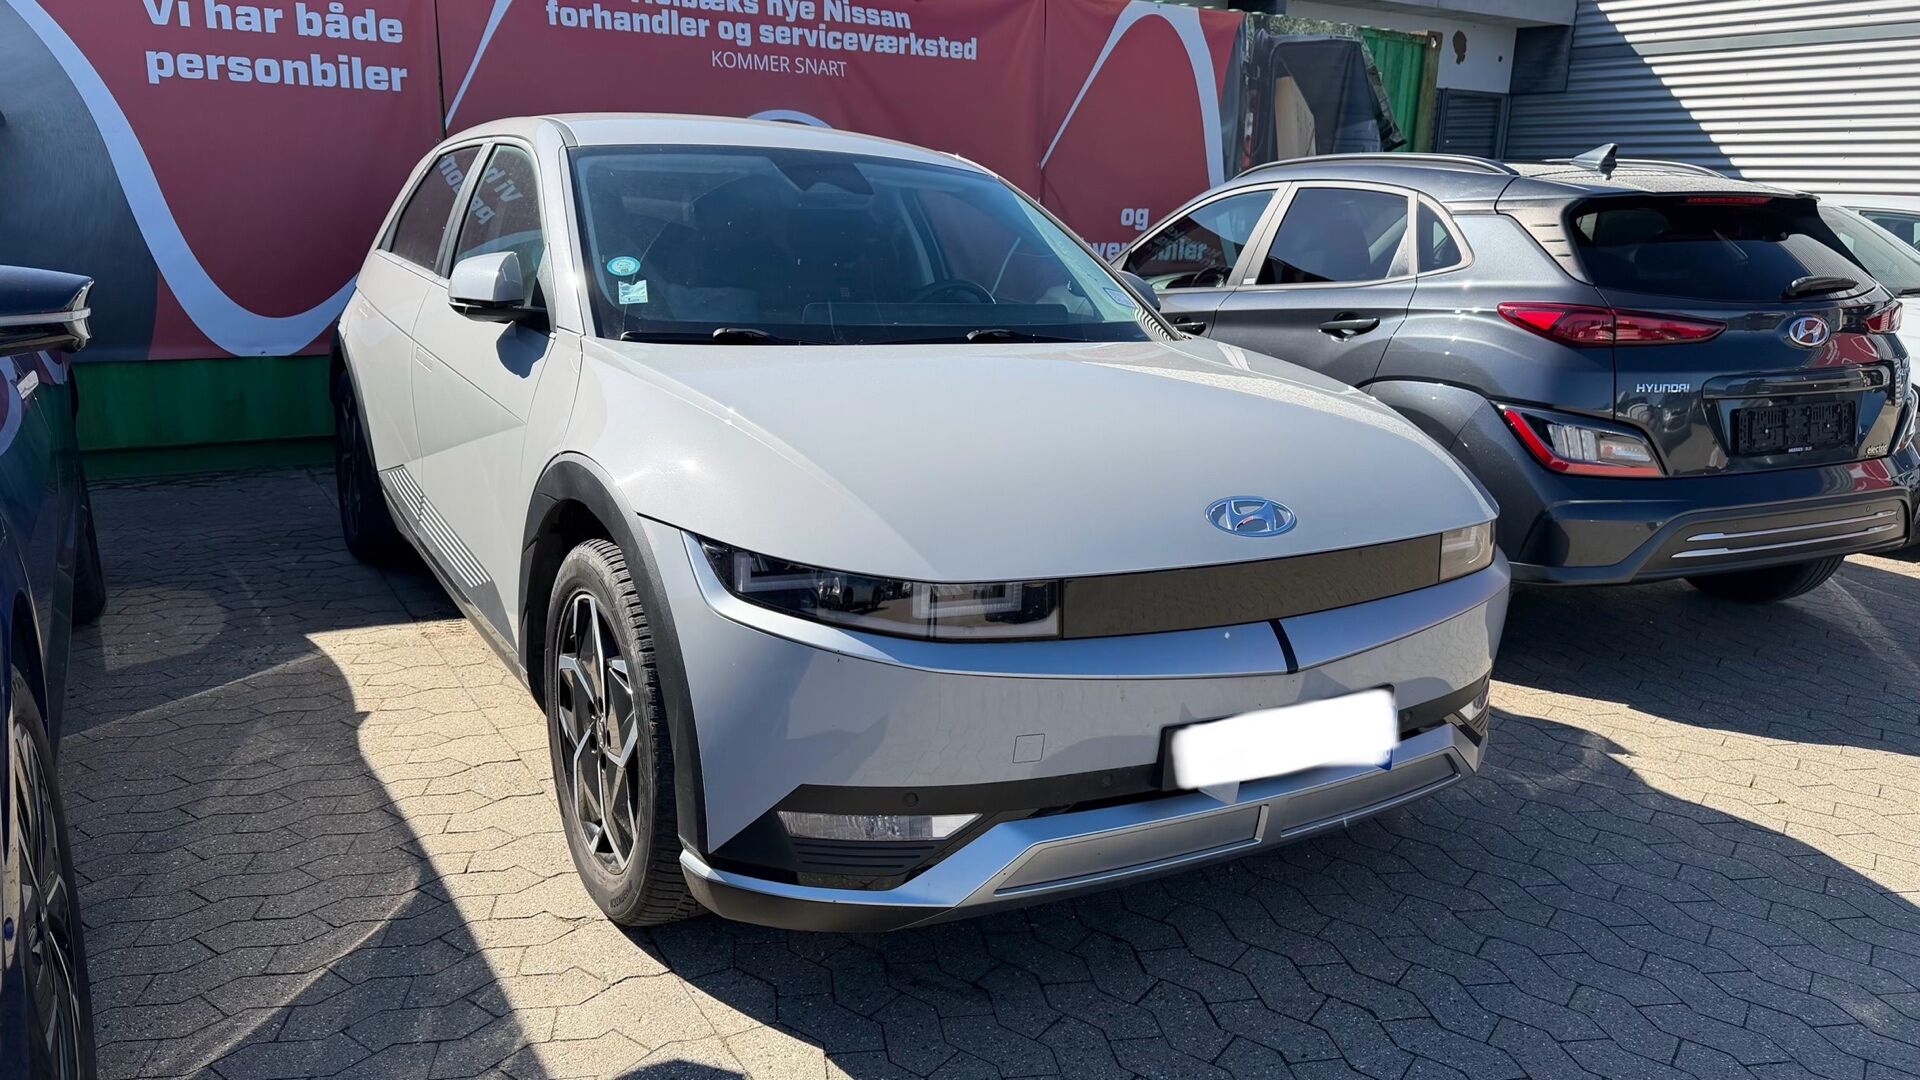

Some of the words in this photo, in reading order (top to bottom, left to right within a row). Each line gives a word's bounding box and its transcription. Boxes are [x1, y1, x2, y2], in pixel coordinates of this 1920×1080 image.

[143, 0, 191, 27] Vi
[205, 0, 283, 33] har
[295, 1, 404, 44] både
[767, 0, 815, 22] nye
[823, 0, 911, 29] Nissan
[545, 0, 710, 37] forhandler
[718, 20, 752, 47] og
[759, 24, 977, 60] serviceværksted
[145, 50, 408, 92] personbiler
[711, 50, 790, 73] KOMMER
[795, 57, 847, 77] SNART
[1120, 207, 1149, 231] og
[1635, 383, 1690, 393] HYUNDAI
